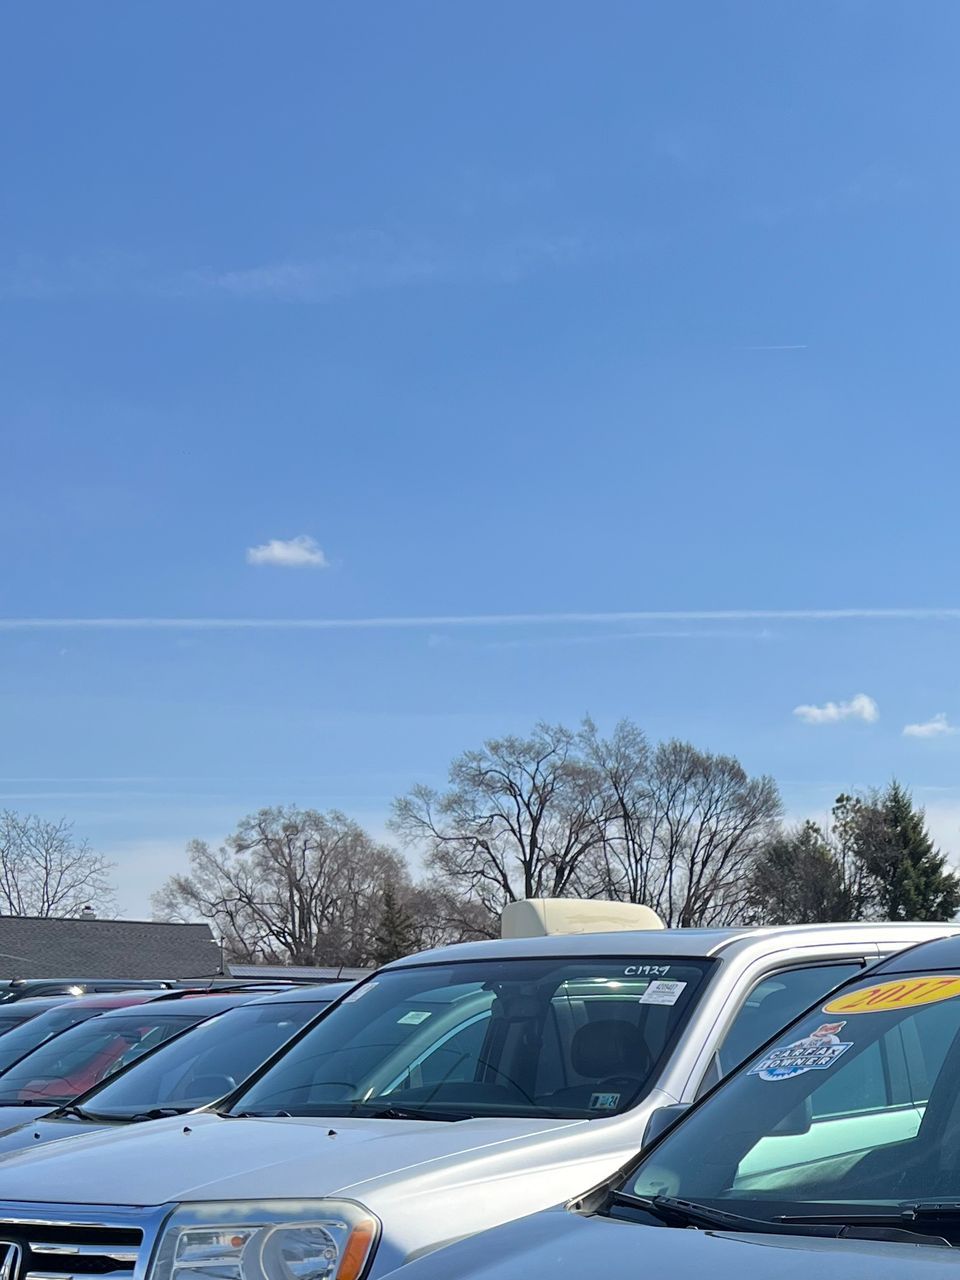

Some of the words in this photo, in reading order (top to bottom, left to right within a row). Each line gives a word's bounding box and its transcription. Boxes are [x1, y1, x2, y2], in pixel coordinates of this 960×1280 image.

[840, 978, 960, 1010] 2017
[770, 1046, 841, 1059] CARFAX
[770, 1056, 831, 1068] OWNER
